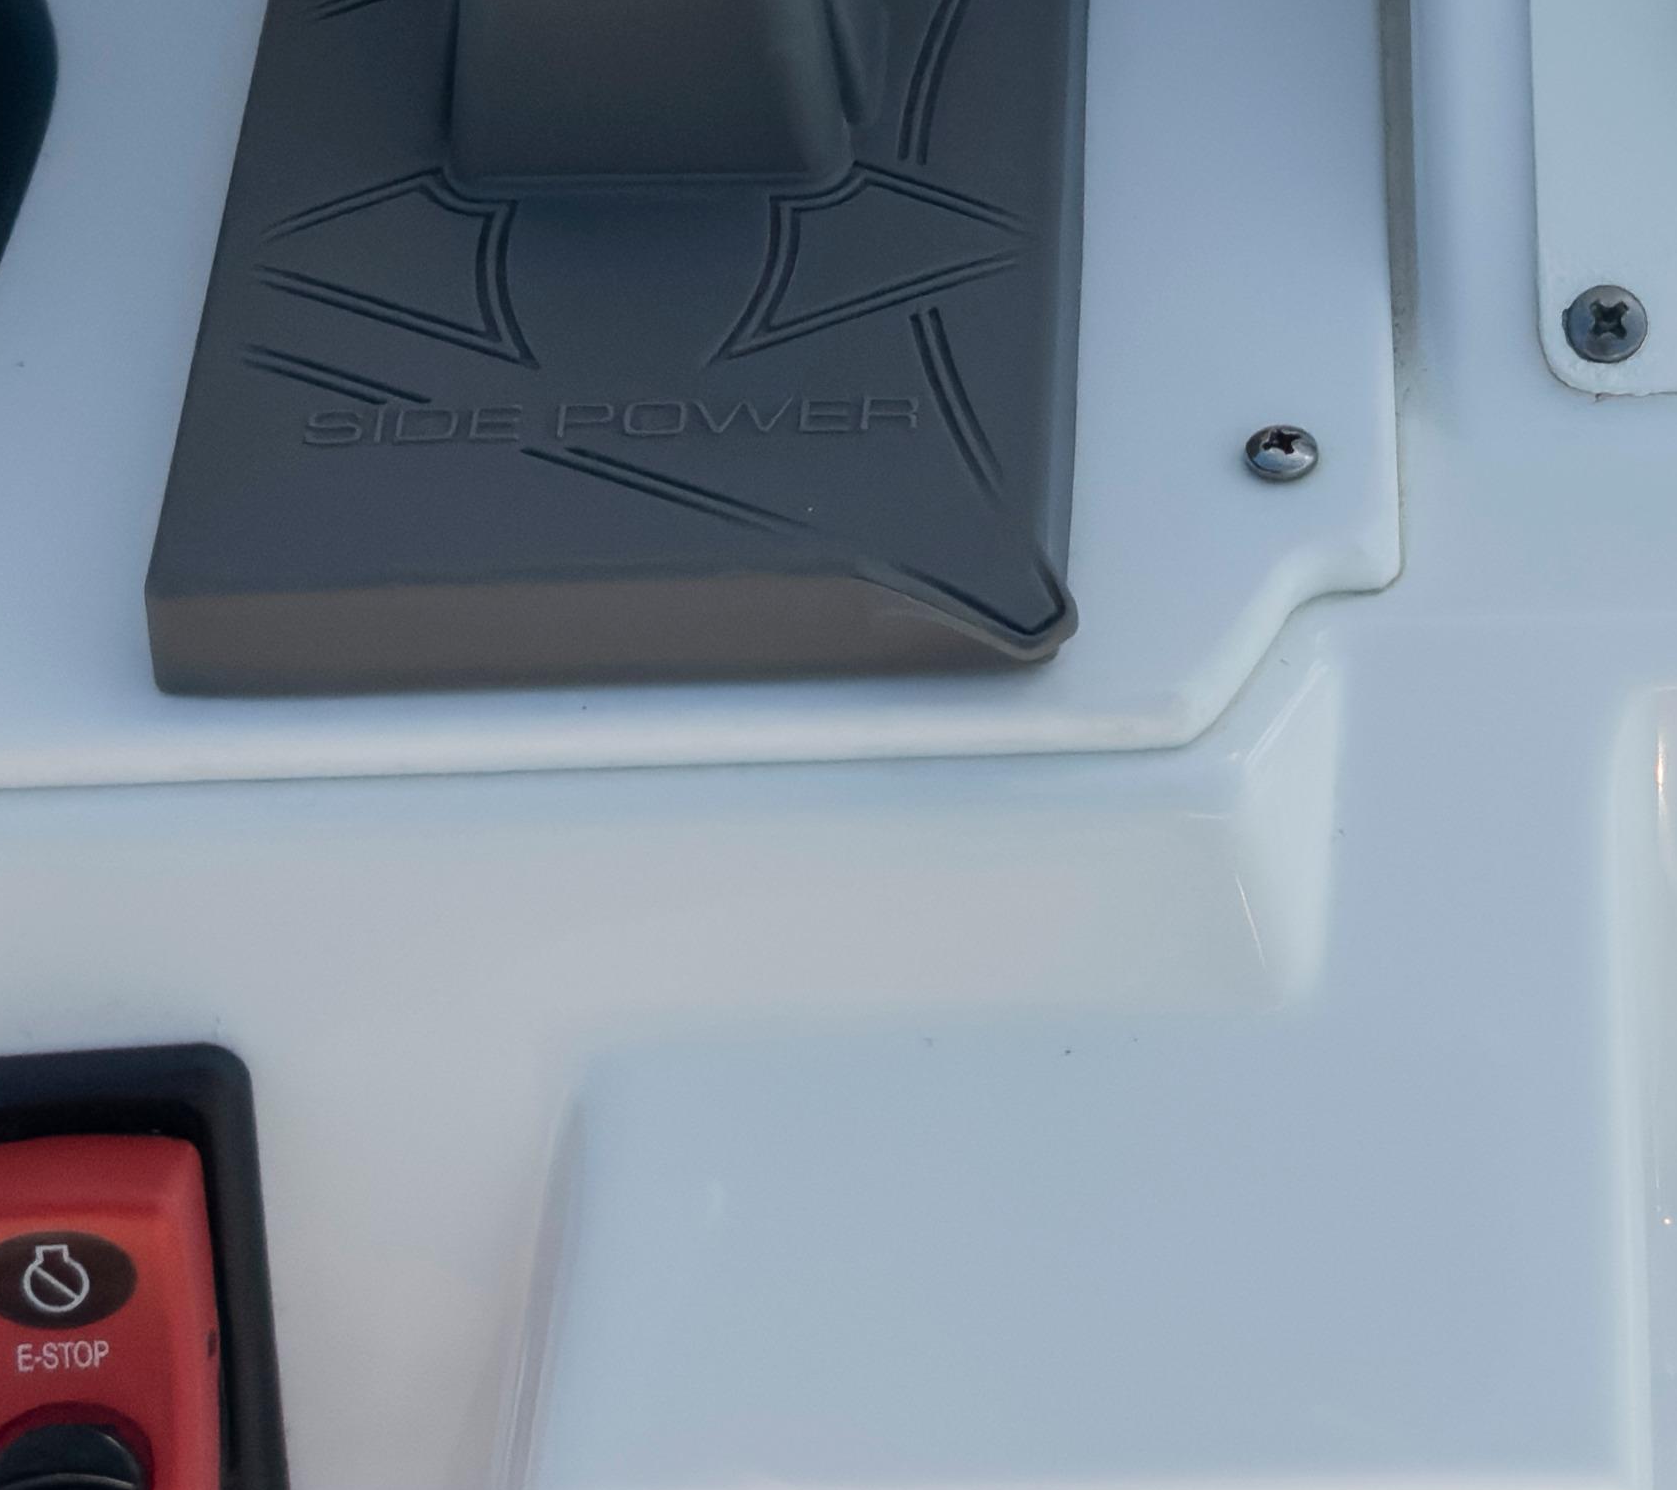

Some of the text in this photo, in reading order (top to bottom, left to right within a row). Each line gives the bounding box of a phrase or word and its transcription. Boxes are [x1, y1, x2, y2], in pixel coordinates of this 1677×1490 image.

[302, 395, 921, 445] SIDE POWER
[16, 1339, 110, 1372] E-STOP
